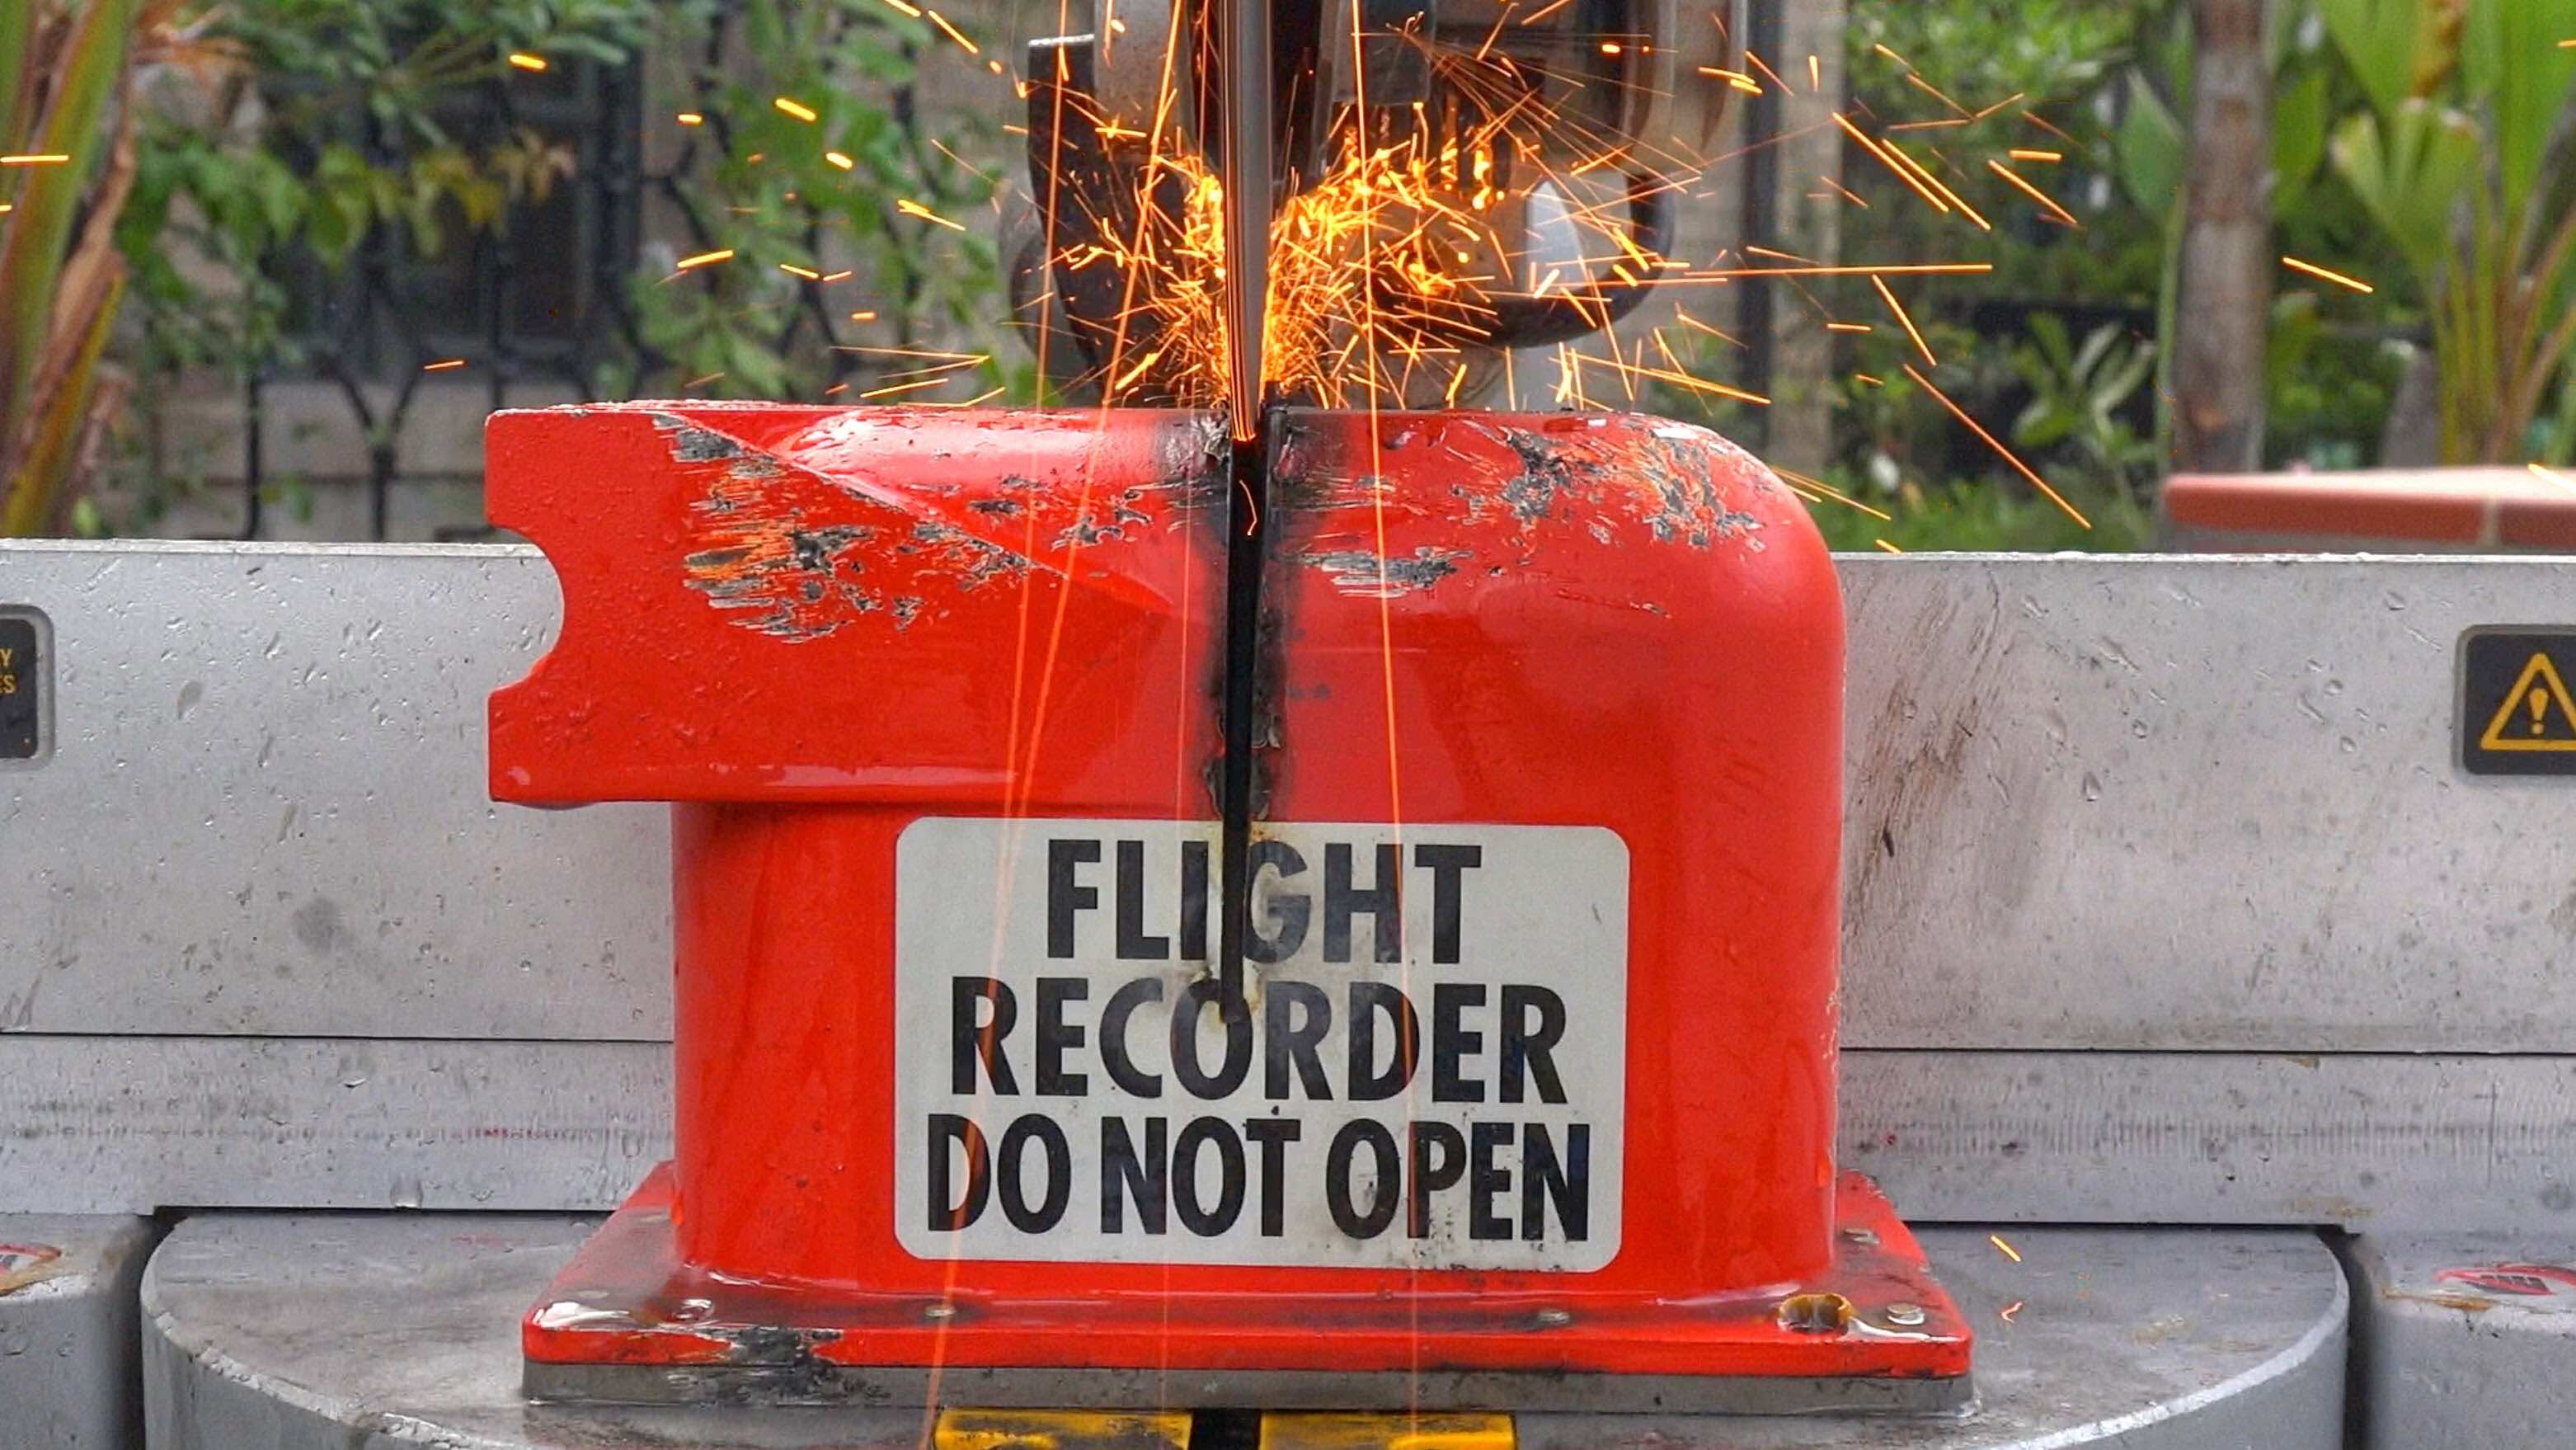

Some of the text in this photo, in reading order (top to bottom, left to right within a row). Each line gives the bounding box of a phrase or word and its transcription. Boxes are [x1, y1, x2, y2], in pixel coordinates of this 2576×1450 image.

[0, 675, 16, 694] S
[1047, 838, 1482, 965] FLIGHT
[952, 976, 1568, 1104] RECORDER
[928, 1113, 1591, 1243] DO NOT OPEN
